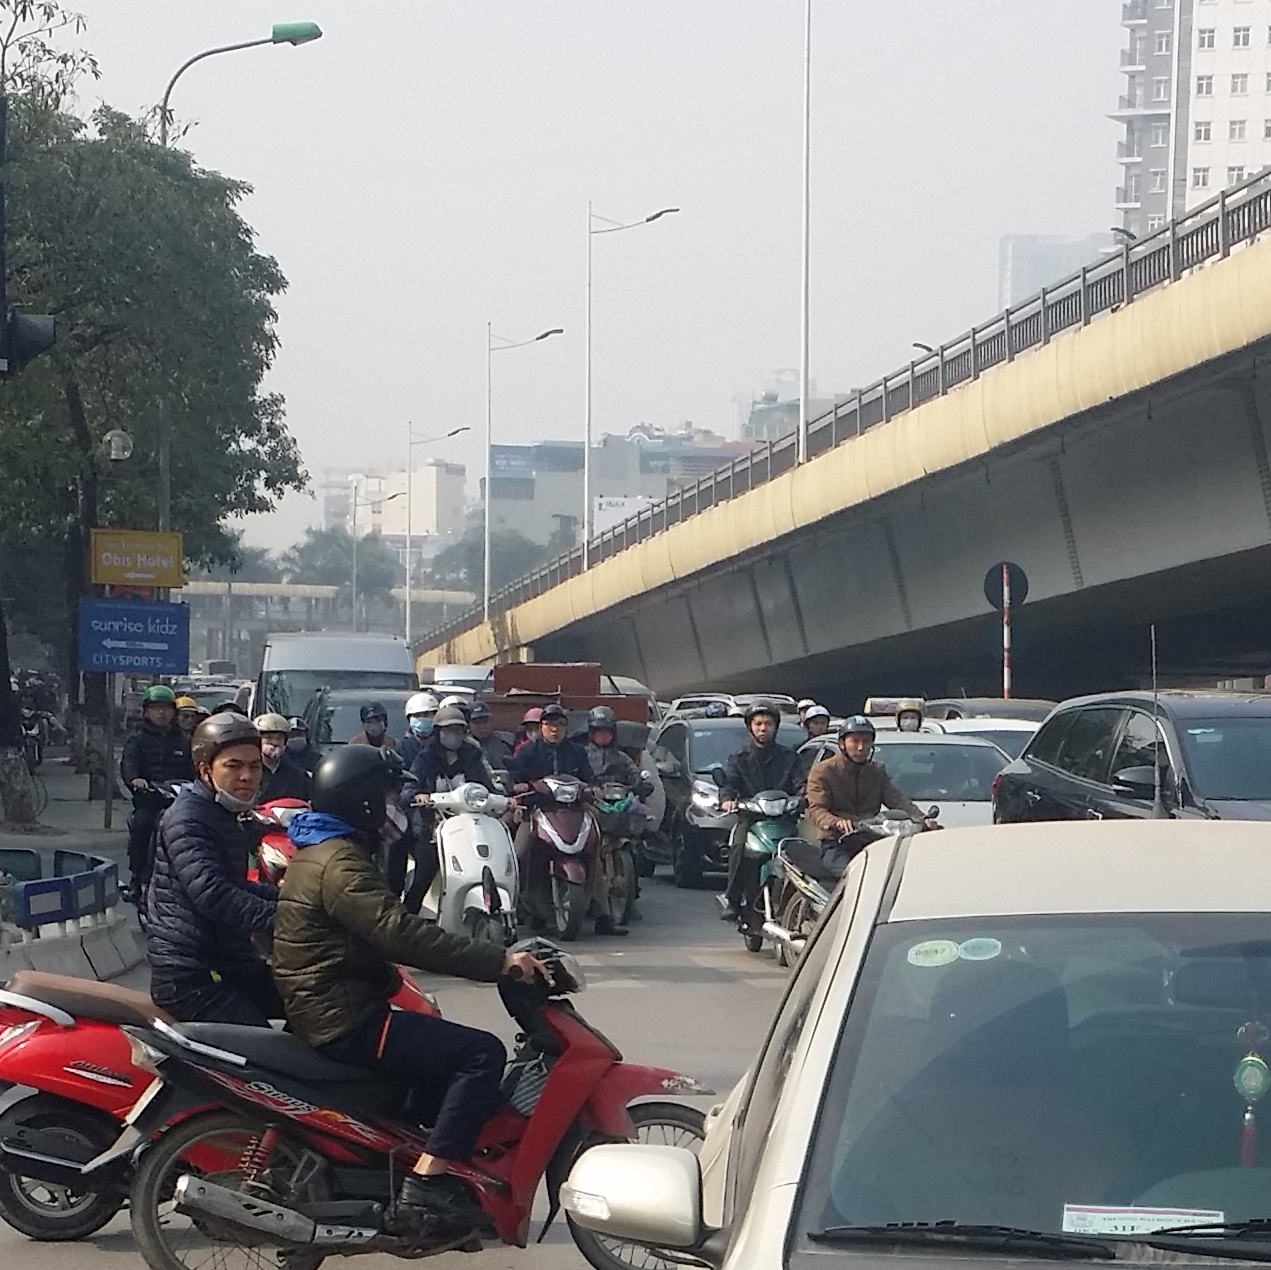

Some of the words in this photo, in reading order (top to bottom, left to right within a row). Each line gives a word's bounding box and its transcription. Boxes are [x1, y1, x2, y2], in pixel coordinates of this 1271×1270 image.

[102, 551, 131, 567] Obis
[137, 553, 173, 569] Hotel
[91, 616, 145, 633] sunrise
[148, 616, 178, 635] kidz
[92, 653, 163, 668] CITYSPORTS
